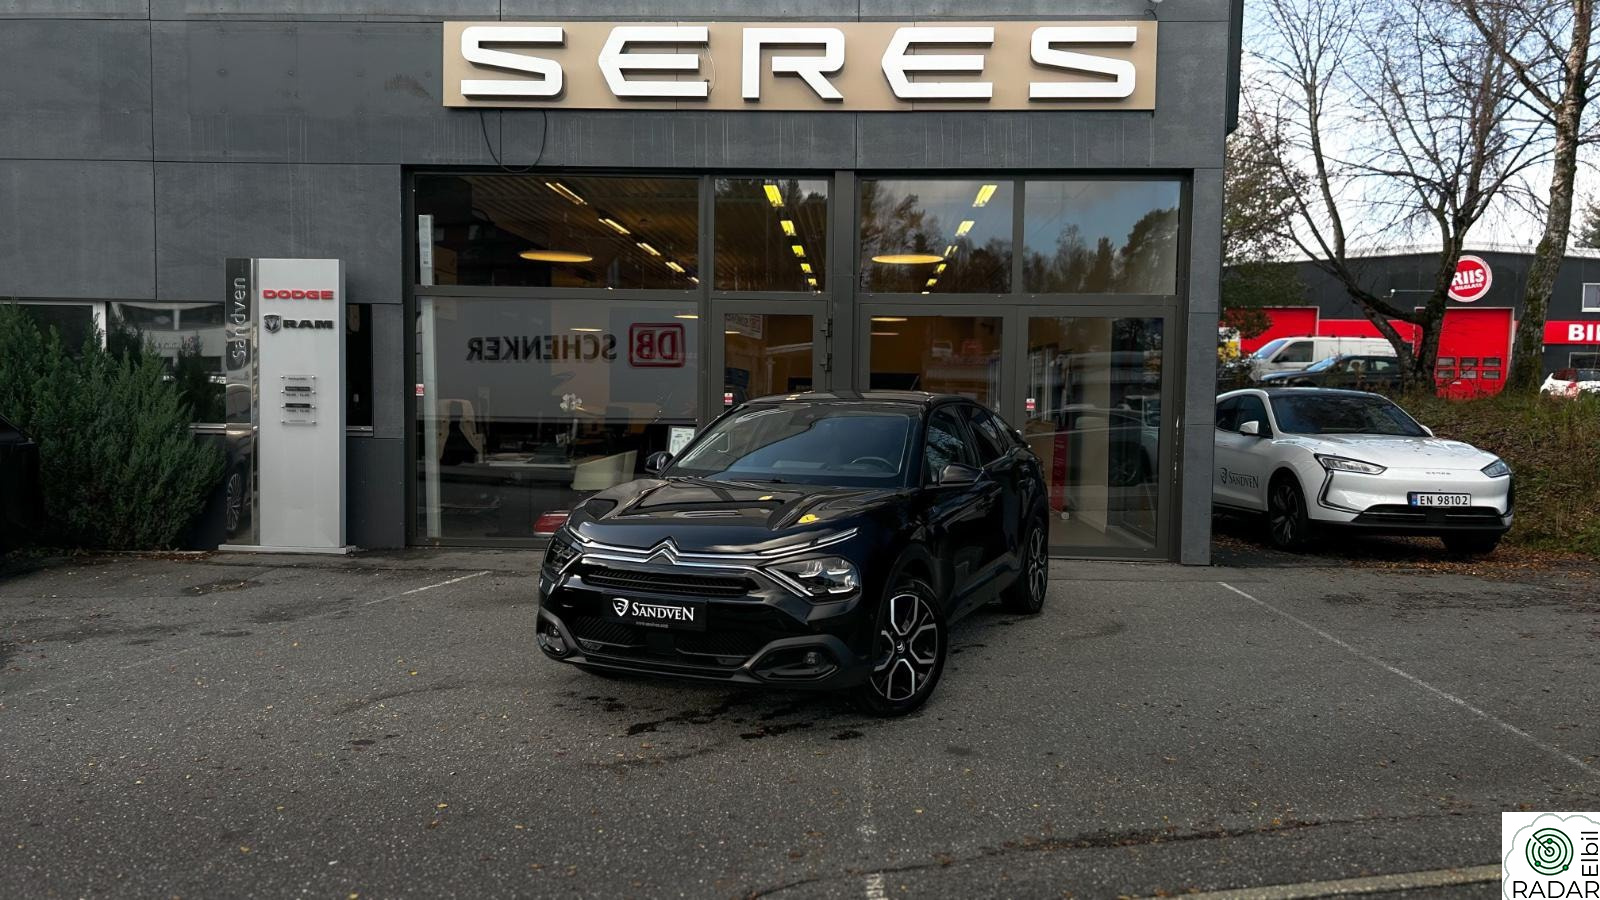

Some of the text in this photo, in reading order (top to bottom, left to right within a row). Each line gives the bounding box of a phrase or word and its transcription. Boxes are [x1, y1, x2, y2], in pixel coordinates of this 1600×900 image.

[460, 26, 1138, 101] SERES
[1452, 269, 1484, 286] RIIS
[263, 290, 334, 300] DODGE
[230, 277, 246, 361] Sandven
[283, 320, 333, 329] RAM
[1420, 495, 1468, 505] EN 98102
